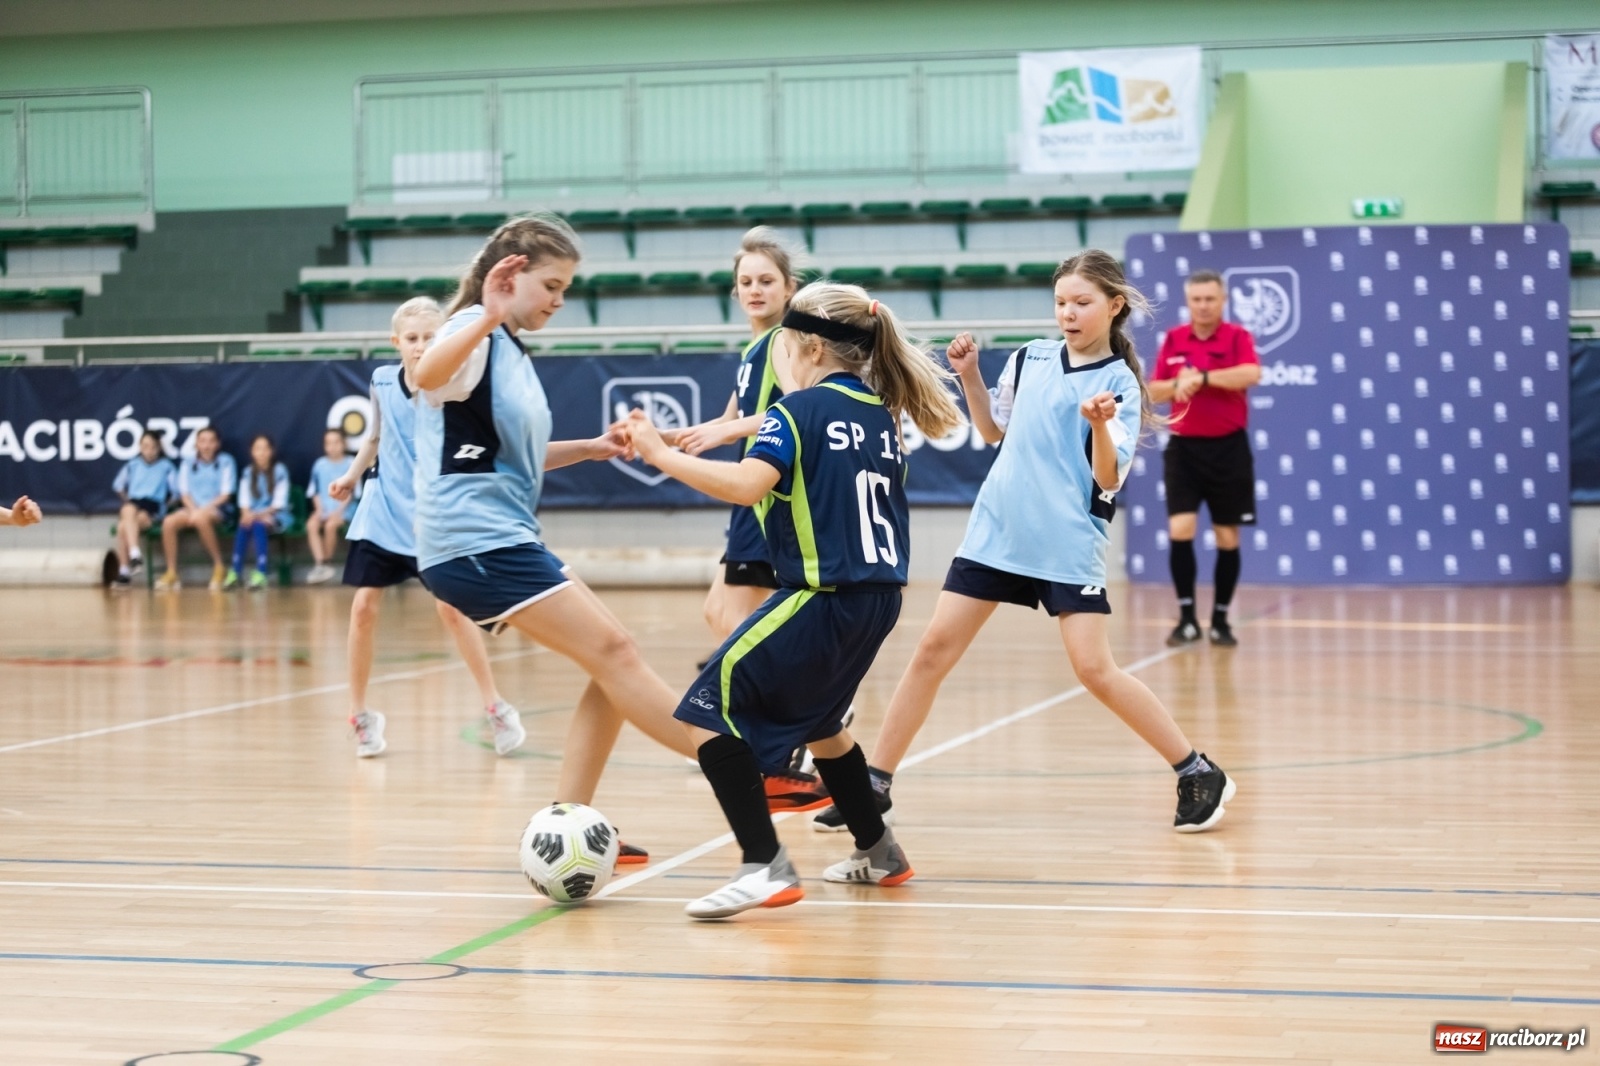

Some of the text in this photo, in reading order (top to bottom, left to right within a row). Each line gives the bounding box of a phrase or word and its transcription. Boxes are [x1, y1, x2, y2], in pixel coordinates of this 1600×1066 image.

[826, 420, 902, 464] SP 1
[855, 468, 898, 568] 15
